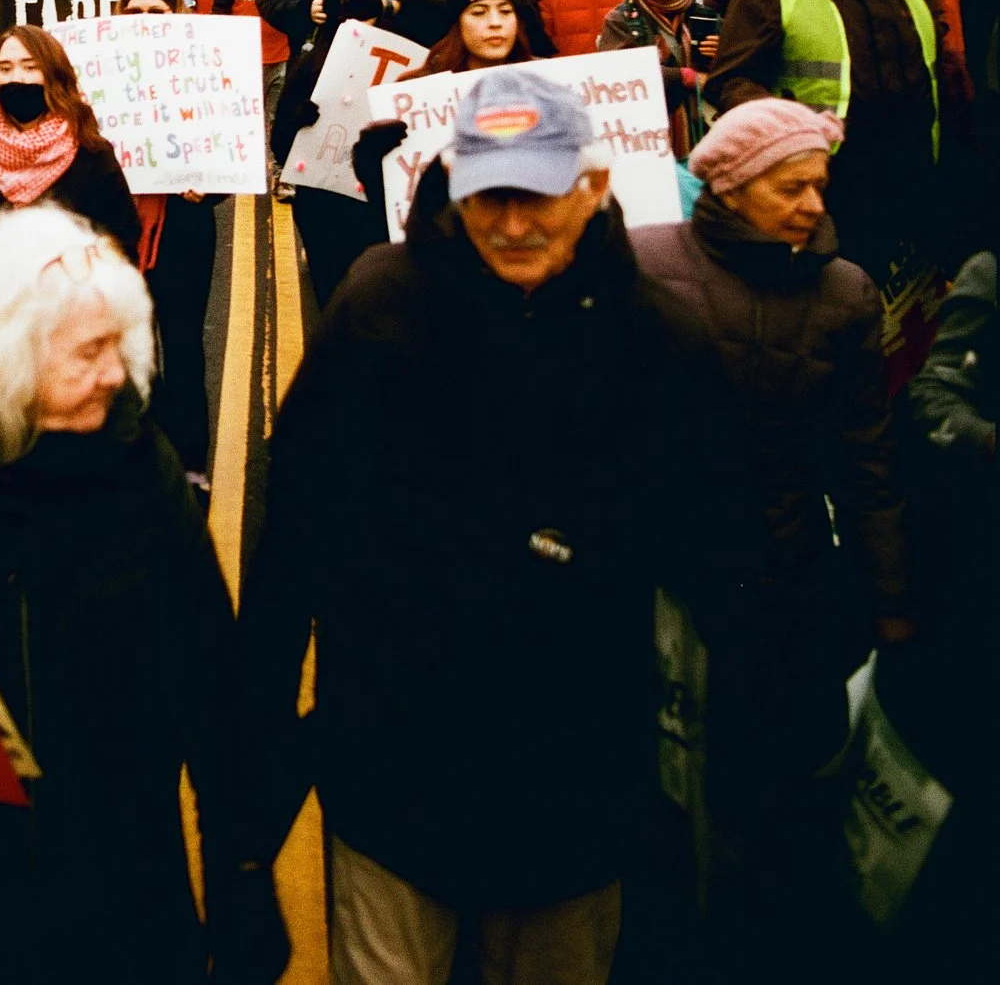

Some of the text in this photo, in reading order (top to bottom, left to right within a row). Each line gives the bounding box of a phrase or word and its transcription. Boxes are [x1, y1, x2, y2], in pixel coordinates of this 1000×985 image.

[185, 22, 196, 40] a
[153, 103, 171, 124] it
[180, 100, 216, 122] will
[112, 136, 158, 168] hat
